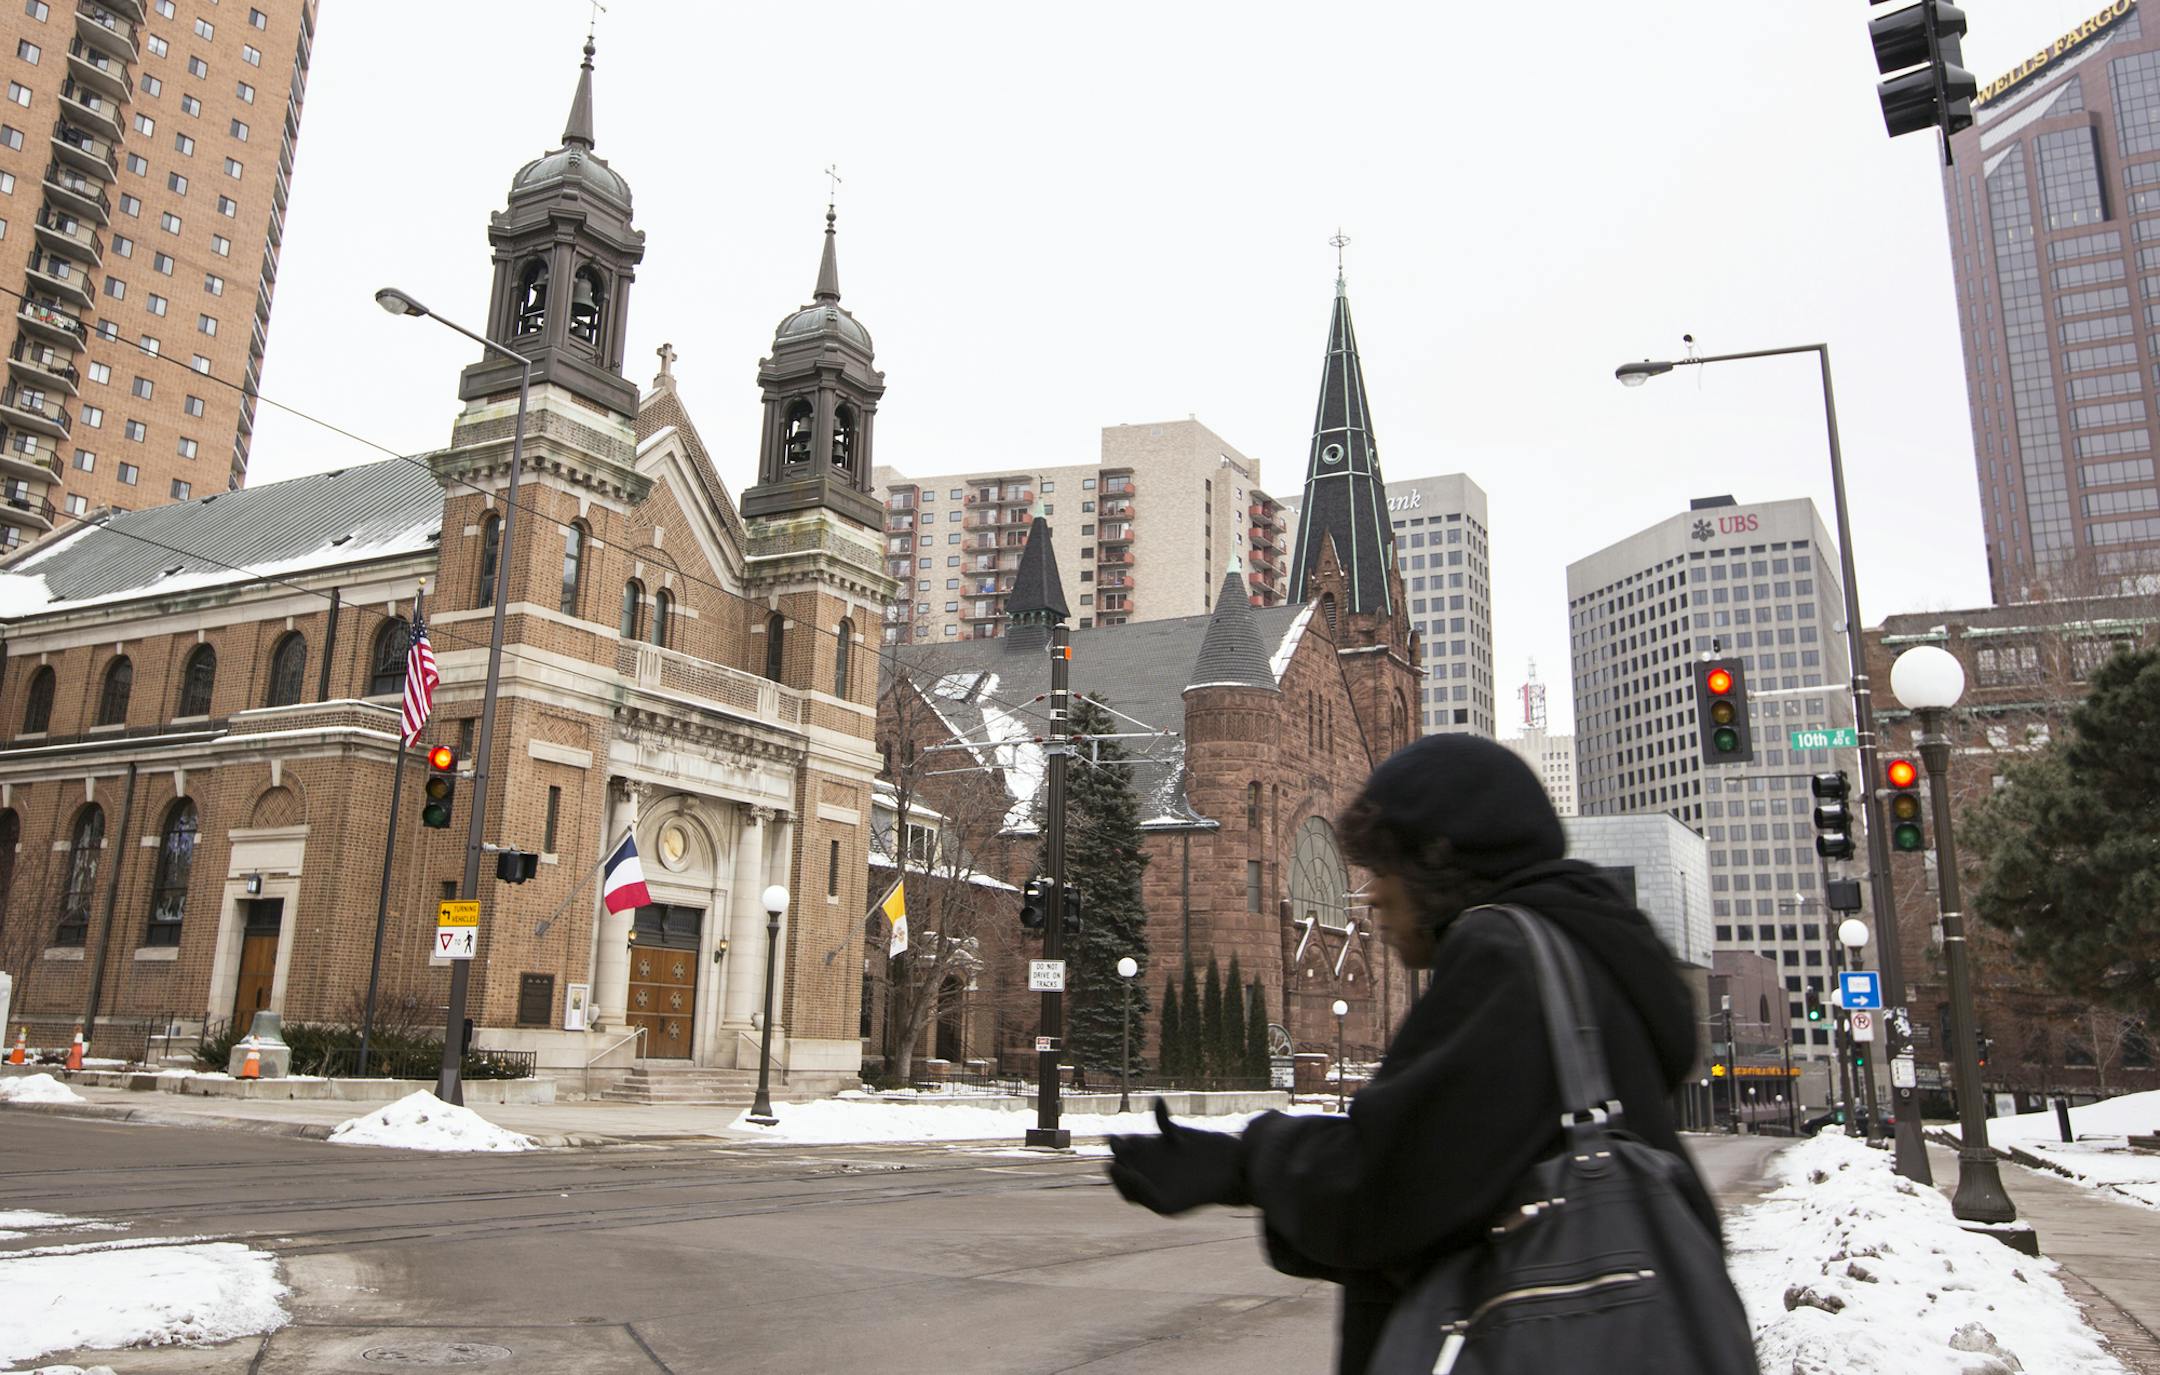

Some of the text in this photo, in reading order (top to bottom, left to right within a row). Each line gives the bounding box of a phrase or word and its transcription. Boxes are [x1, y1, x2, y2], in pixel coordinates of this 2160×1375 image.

[1977, 0, 2131, 105] WELLS FARGO
[1386, 489, 1421, 512] ank
[1718, 513, 1759, 535] UBS
[1797, 732, 1828, 748] 10th
[454, 905, 477, 913] TURNING
[452, 915, 476, 923] VEHICLES
[454, 938, 462, 946] TO
